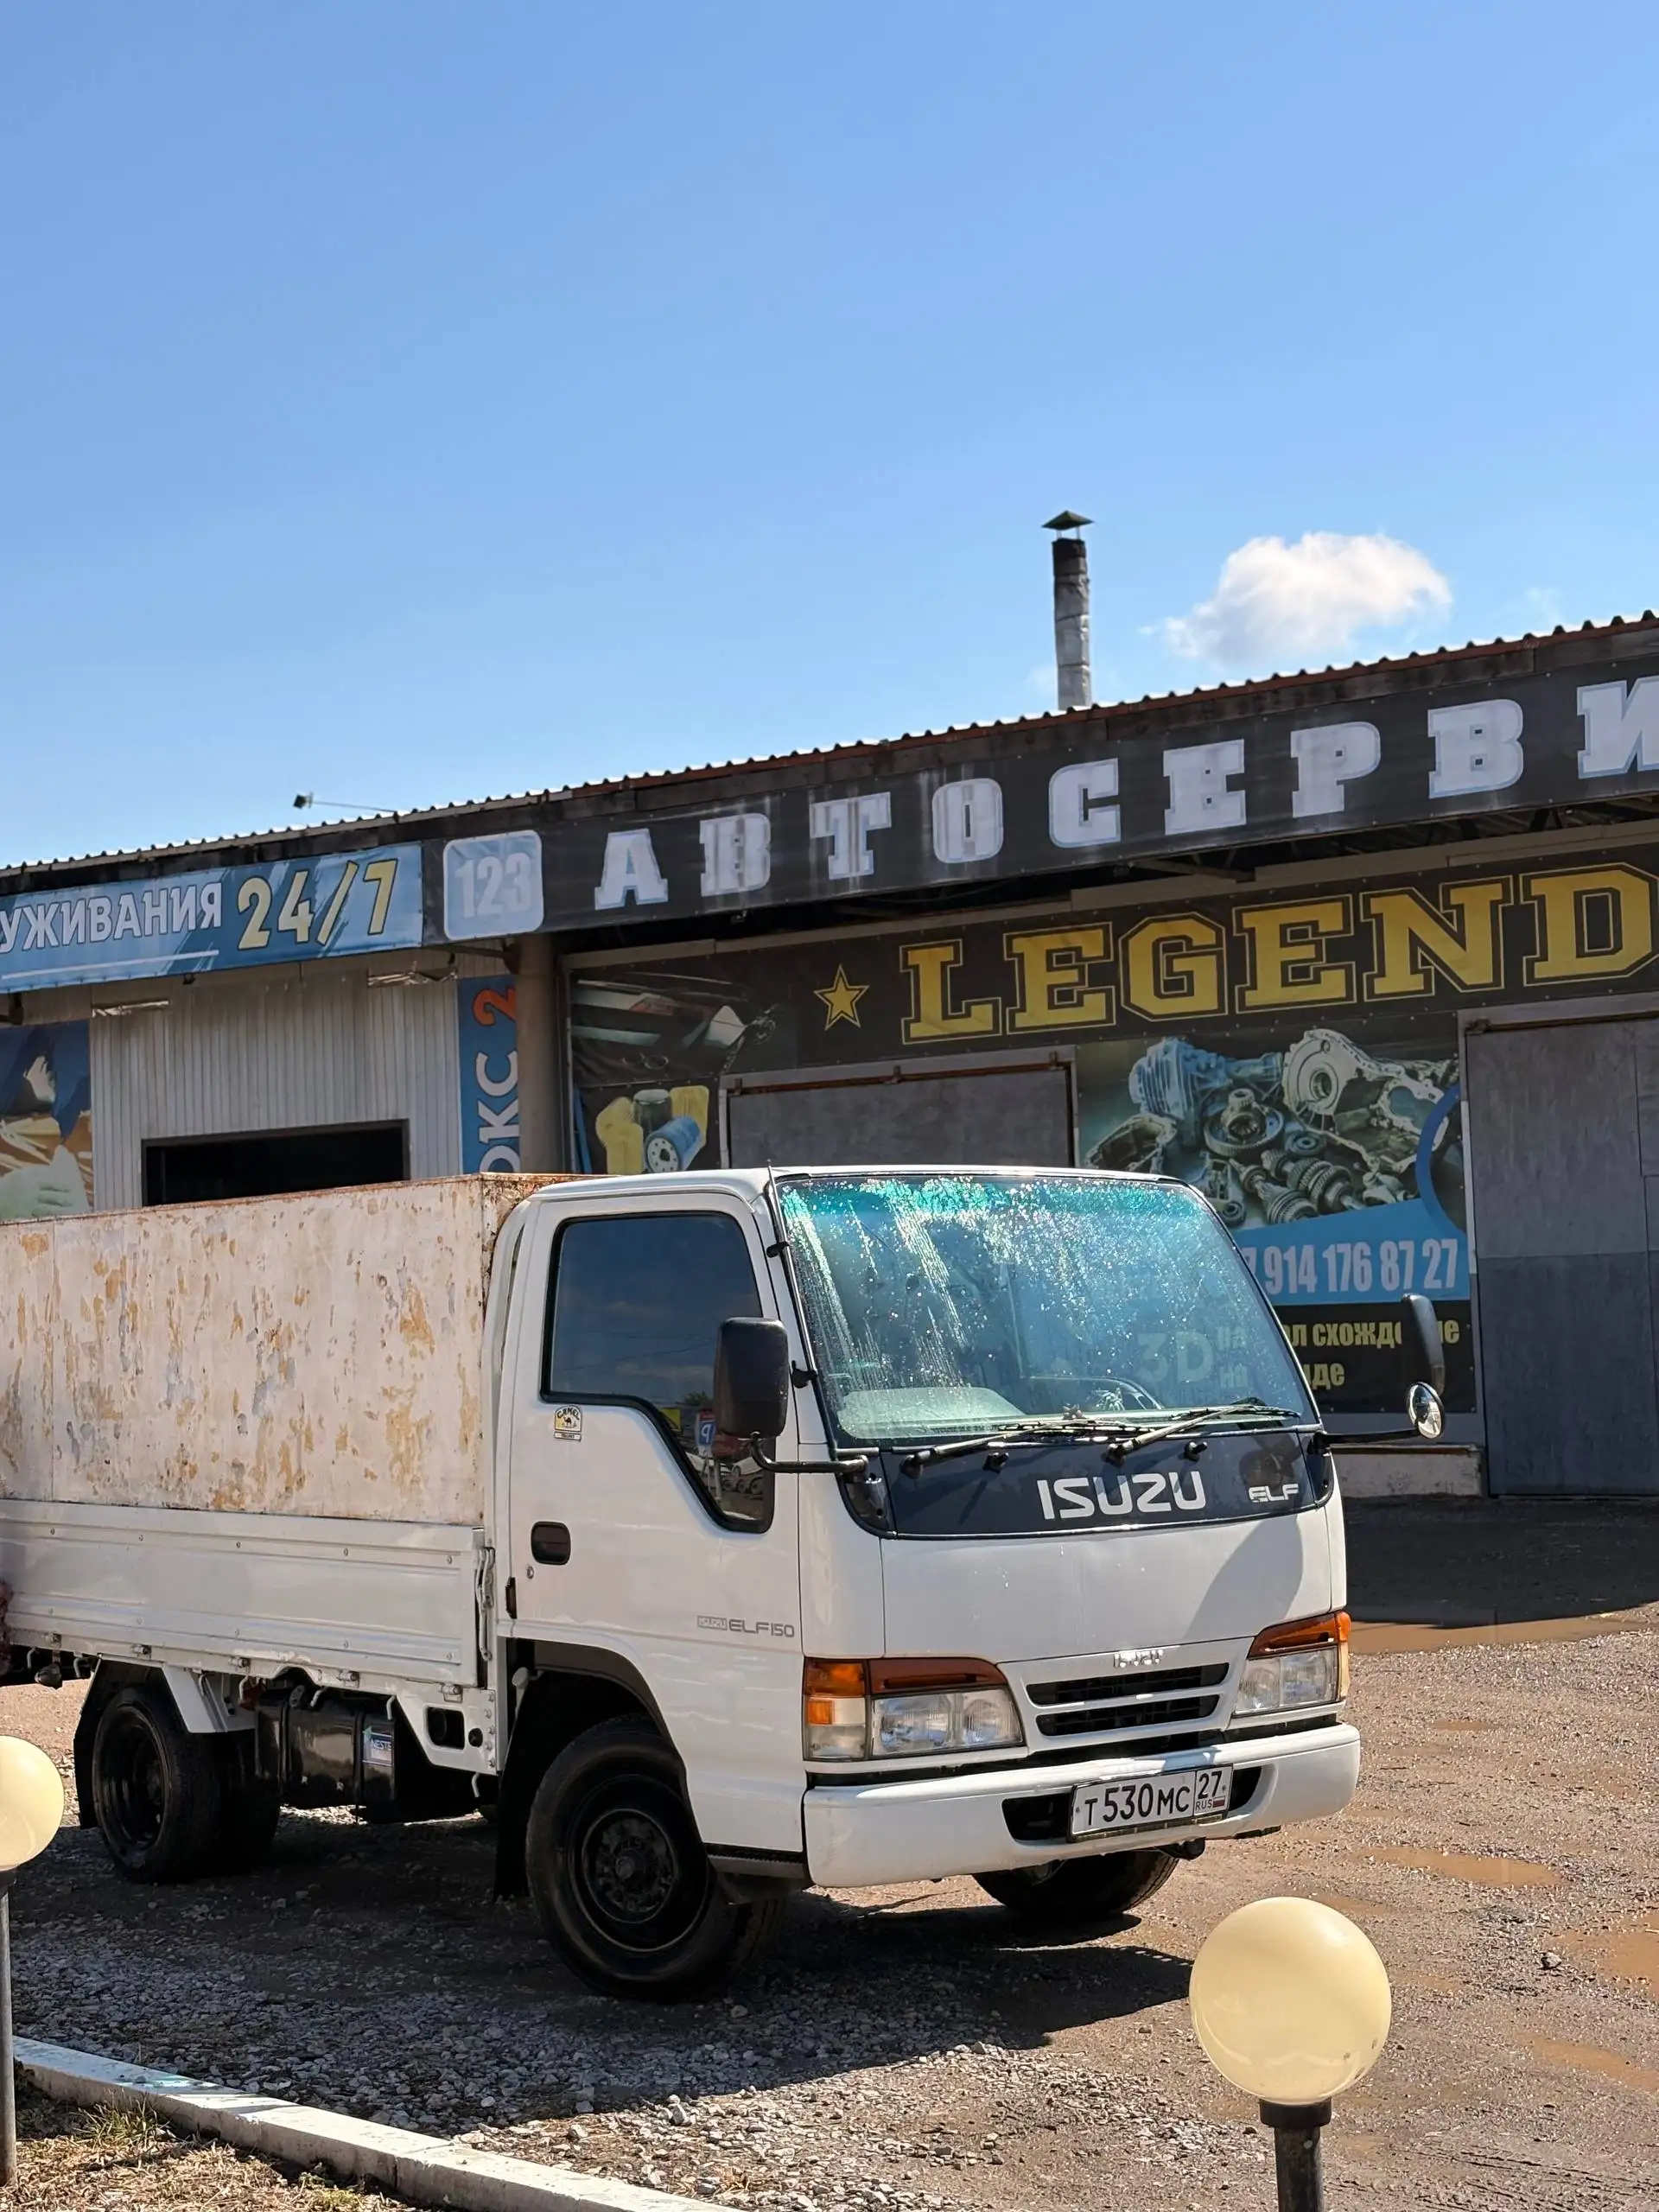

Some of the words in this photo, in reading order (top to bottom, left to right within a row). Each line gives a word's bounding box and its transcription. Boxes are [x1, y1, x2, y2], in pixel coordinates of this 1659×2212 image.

[238, 859, 399, 950] 24/7
[454, 852, 532, 918] 123
[899, 862, 1659, 1046] LEGEND
[473, 987, 516, 1027] 2
[1263, 1244, 1318, 1294] 914
[1322, 1242, 1372, 1293] 176
[1380, 1240, 1414, 1291] 87
[1422, 1238, 1458, 1289] 27
[1037, 1471, 1206, 1520] ISUZU
[1249, 1484, 1299, 1503] ELF
[1195, 1798, 1212, 1810] RUS
[1198, 1770, 1223, 1800] 27
